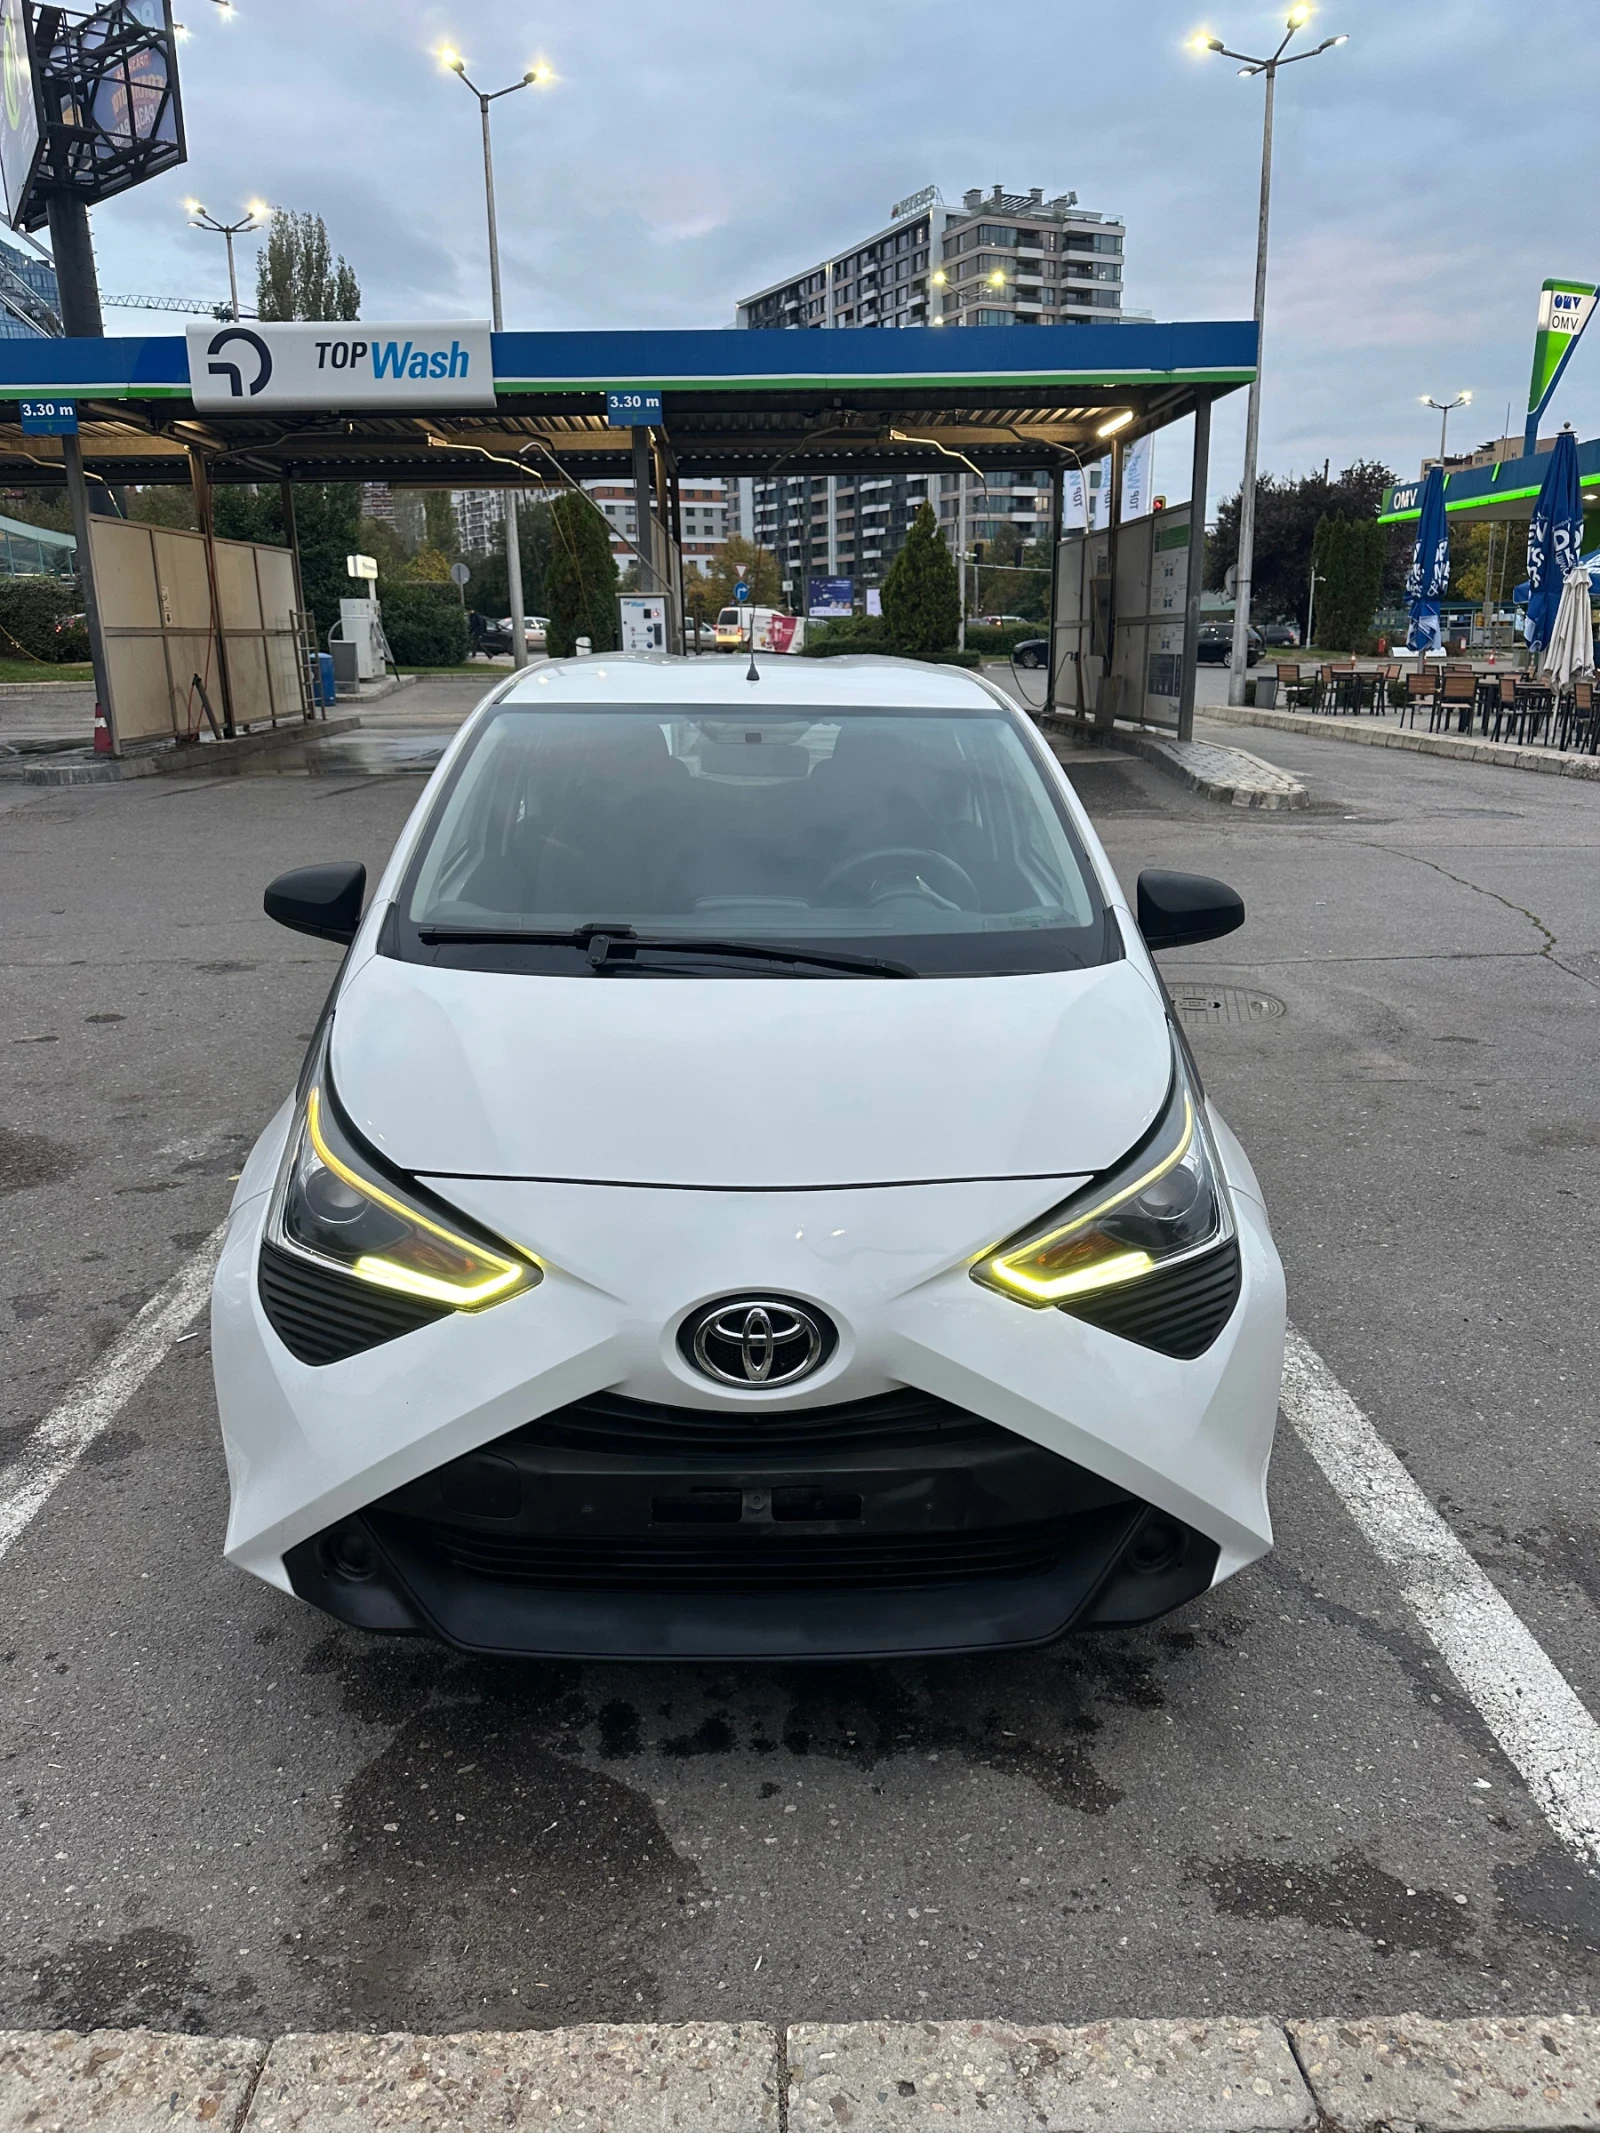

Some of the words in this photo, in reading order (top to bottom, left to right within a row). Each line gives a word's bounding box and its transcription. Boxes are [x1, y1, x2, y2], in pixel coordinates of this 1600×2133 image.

[1552, 315, 1579, 330] OMV
[610, 395, 642, 408] 3.30
[645, 397, 660, 408] m
[22, 403, 55, 416] 3.30
[59, 406, 74, 416] m
[1393, 487, 1418, 510] OMV
